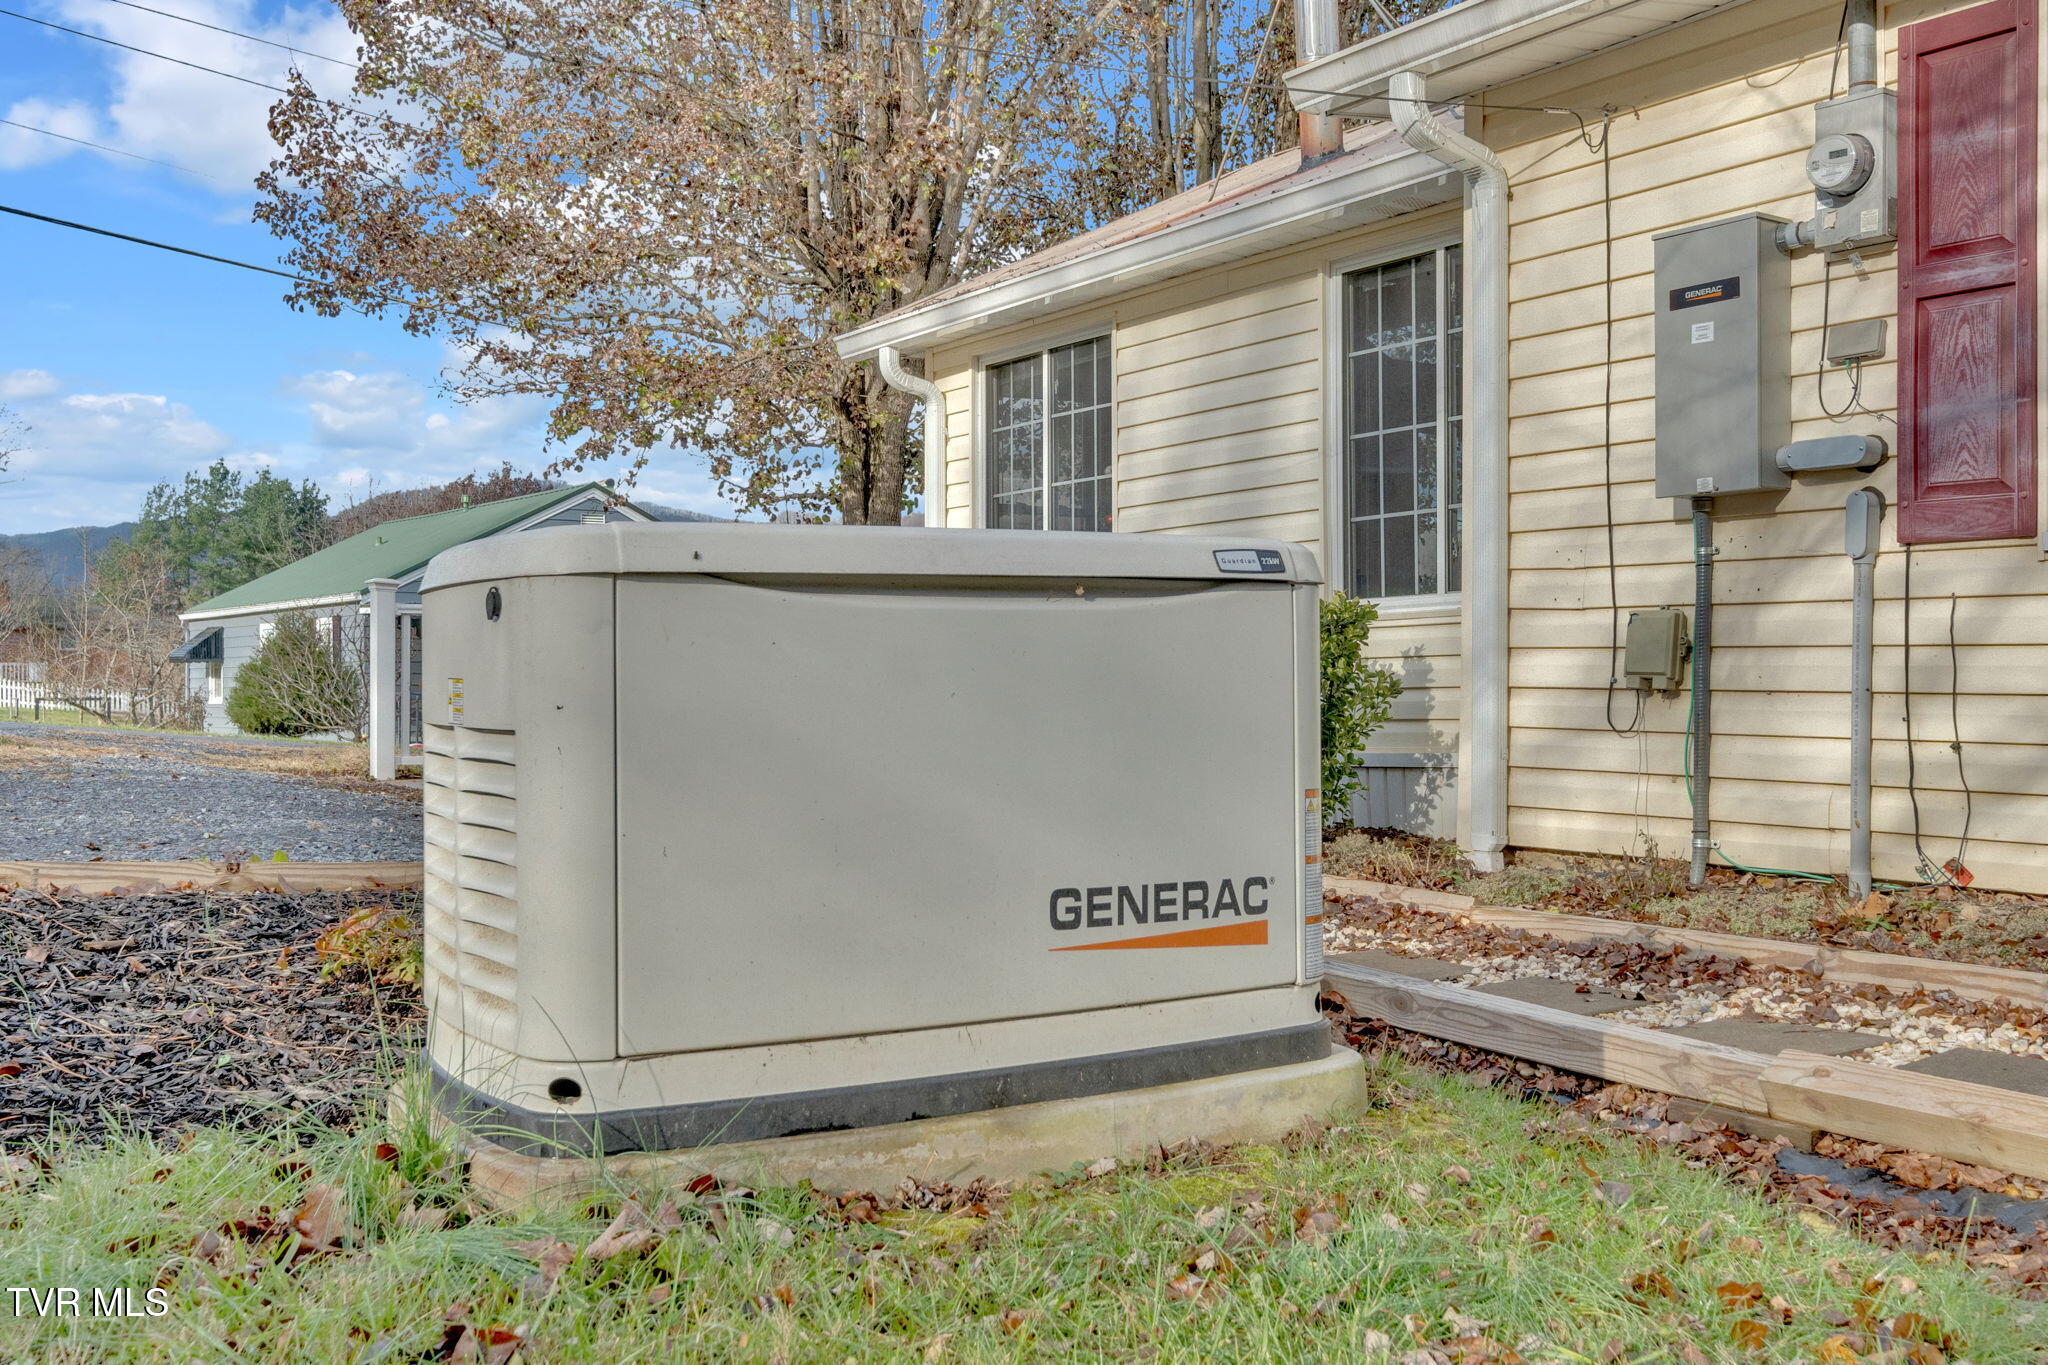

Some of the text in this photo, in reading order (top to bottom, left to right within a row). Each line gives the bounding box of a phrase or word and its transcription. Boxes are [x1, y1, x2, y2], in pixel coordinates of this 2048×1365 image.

[1685, 285, 1722, 299] GENERAC
[1221, 557, 1257, 565] Guardian
[1050, 876, 1268, 931] GENERAC
